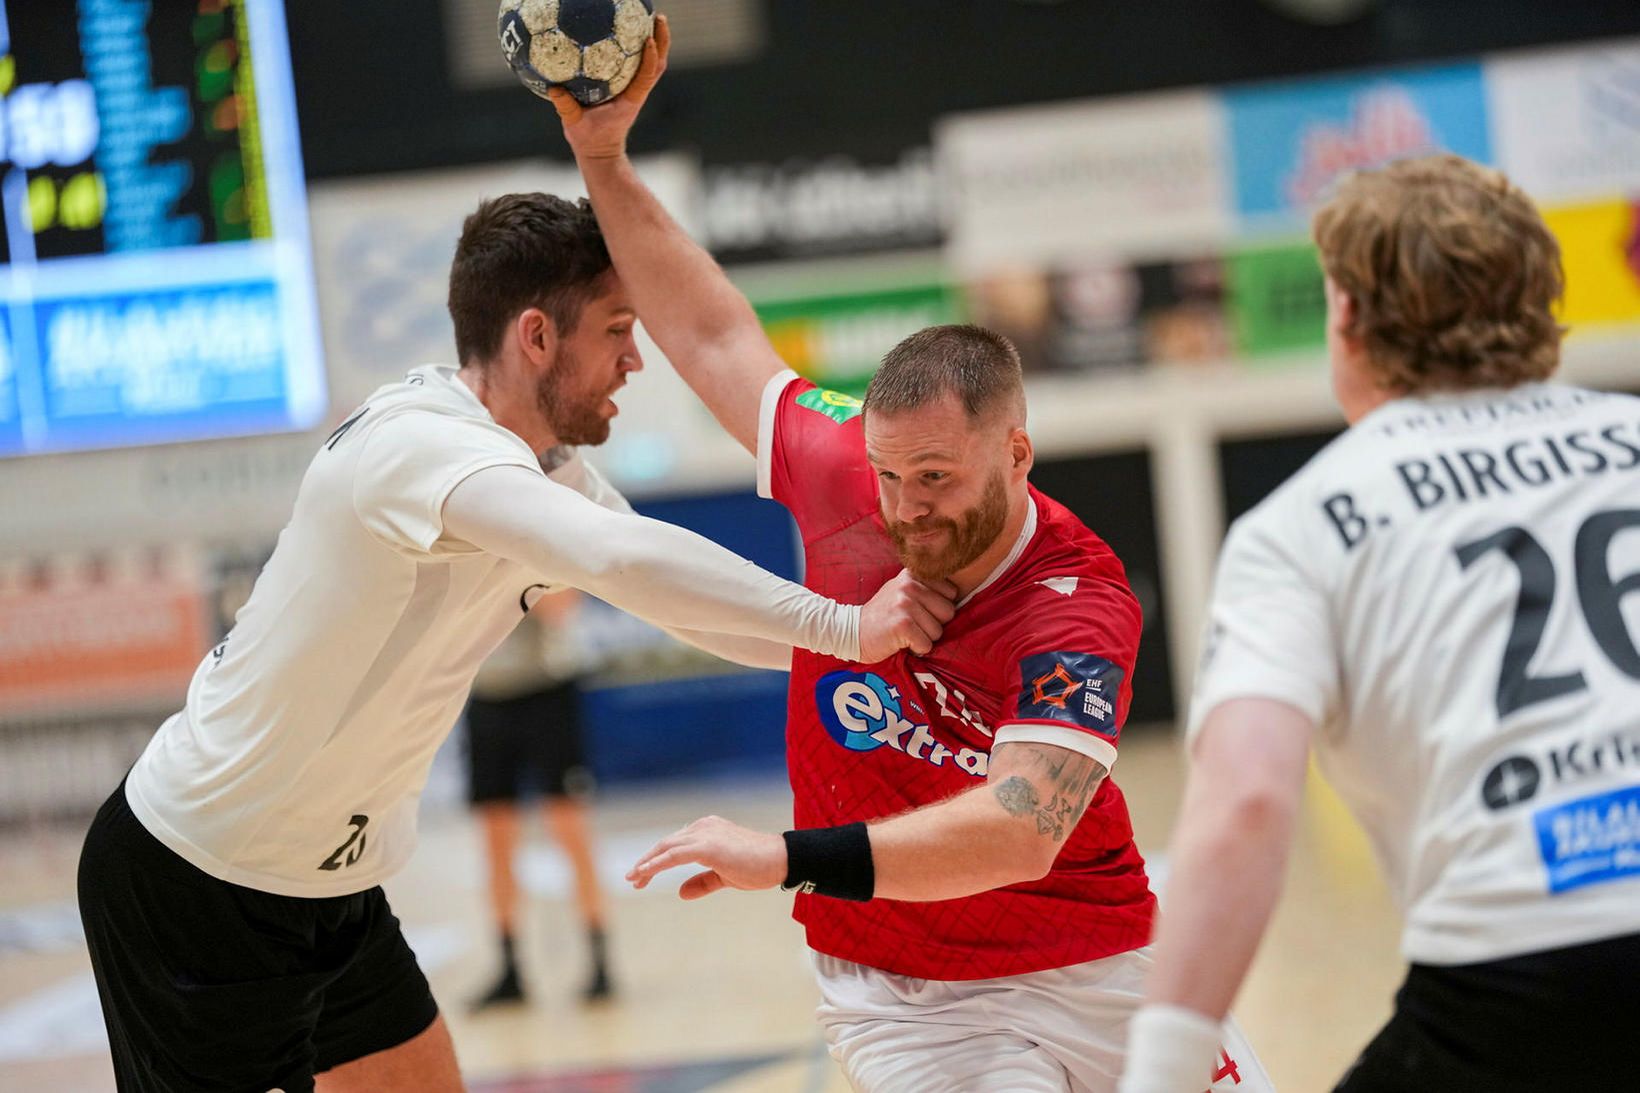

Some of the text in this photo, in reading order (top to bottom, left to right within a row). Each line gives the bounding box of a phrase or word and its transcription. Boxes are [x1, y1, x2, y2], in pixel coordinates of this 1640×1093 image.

[1322, 422, 1640, 549] B. BIRGISS
[1454, 508, 1640, 720] 26
[1084, 692, 1113, 715] EUROPEAN
[1086, 679, 1102, 688] EHF
[832, 681, 990, 777] extra
[1083, 703, 1105, 721] LEAGUE
[1549, 734, 1640, 779] Kri
